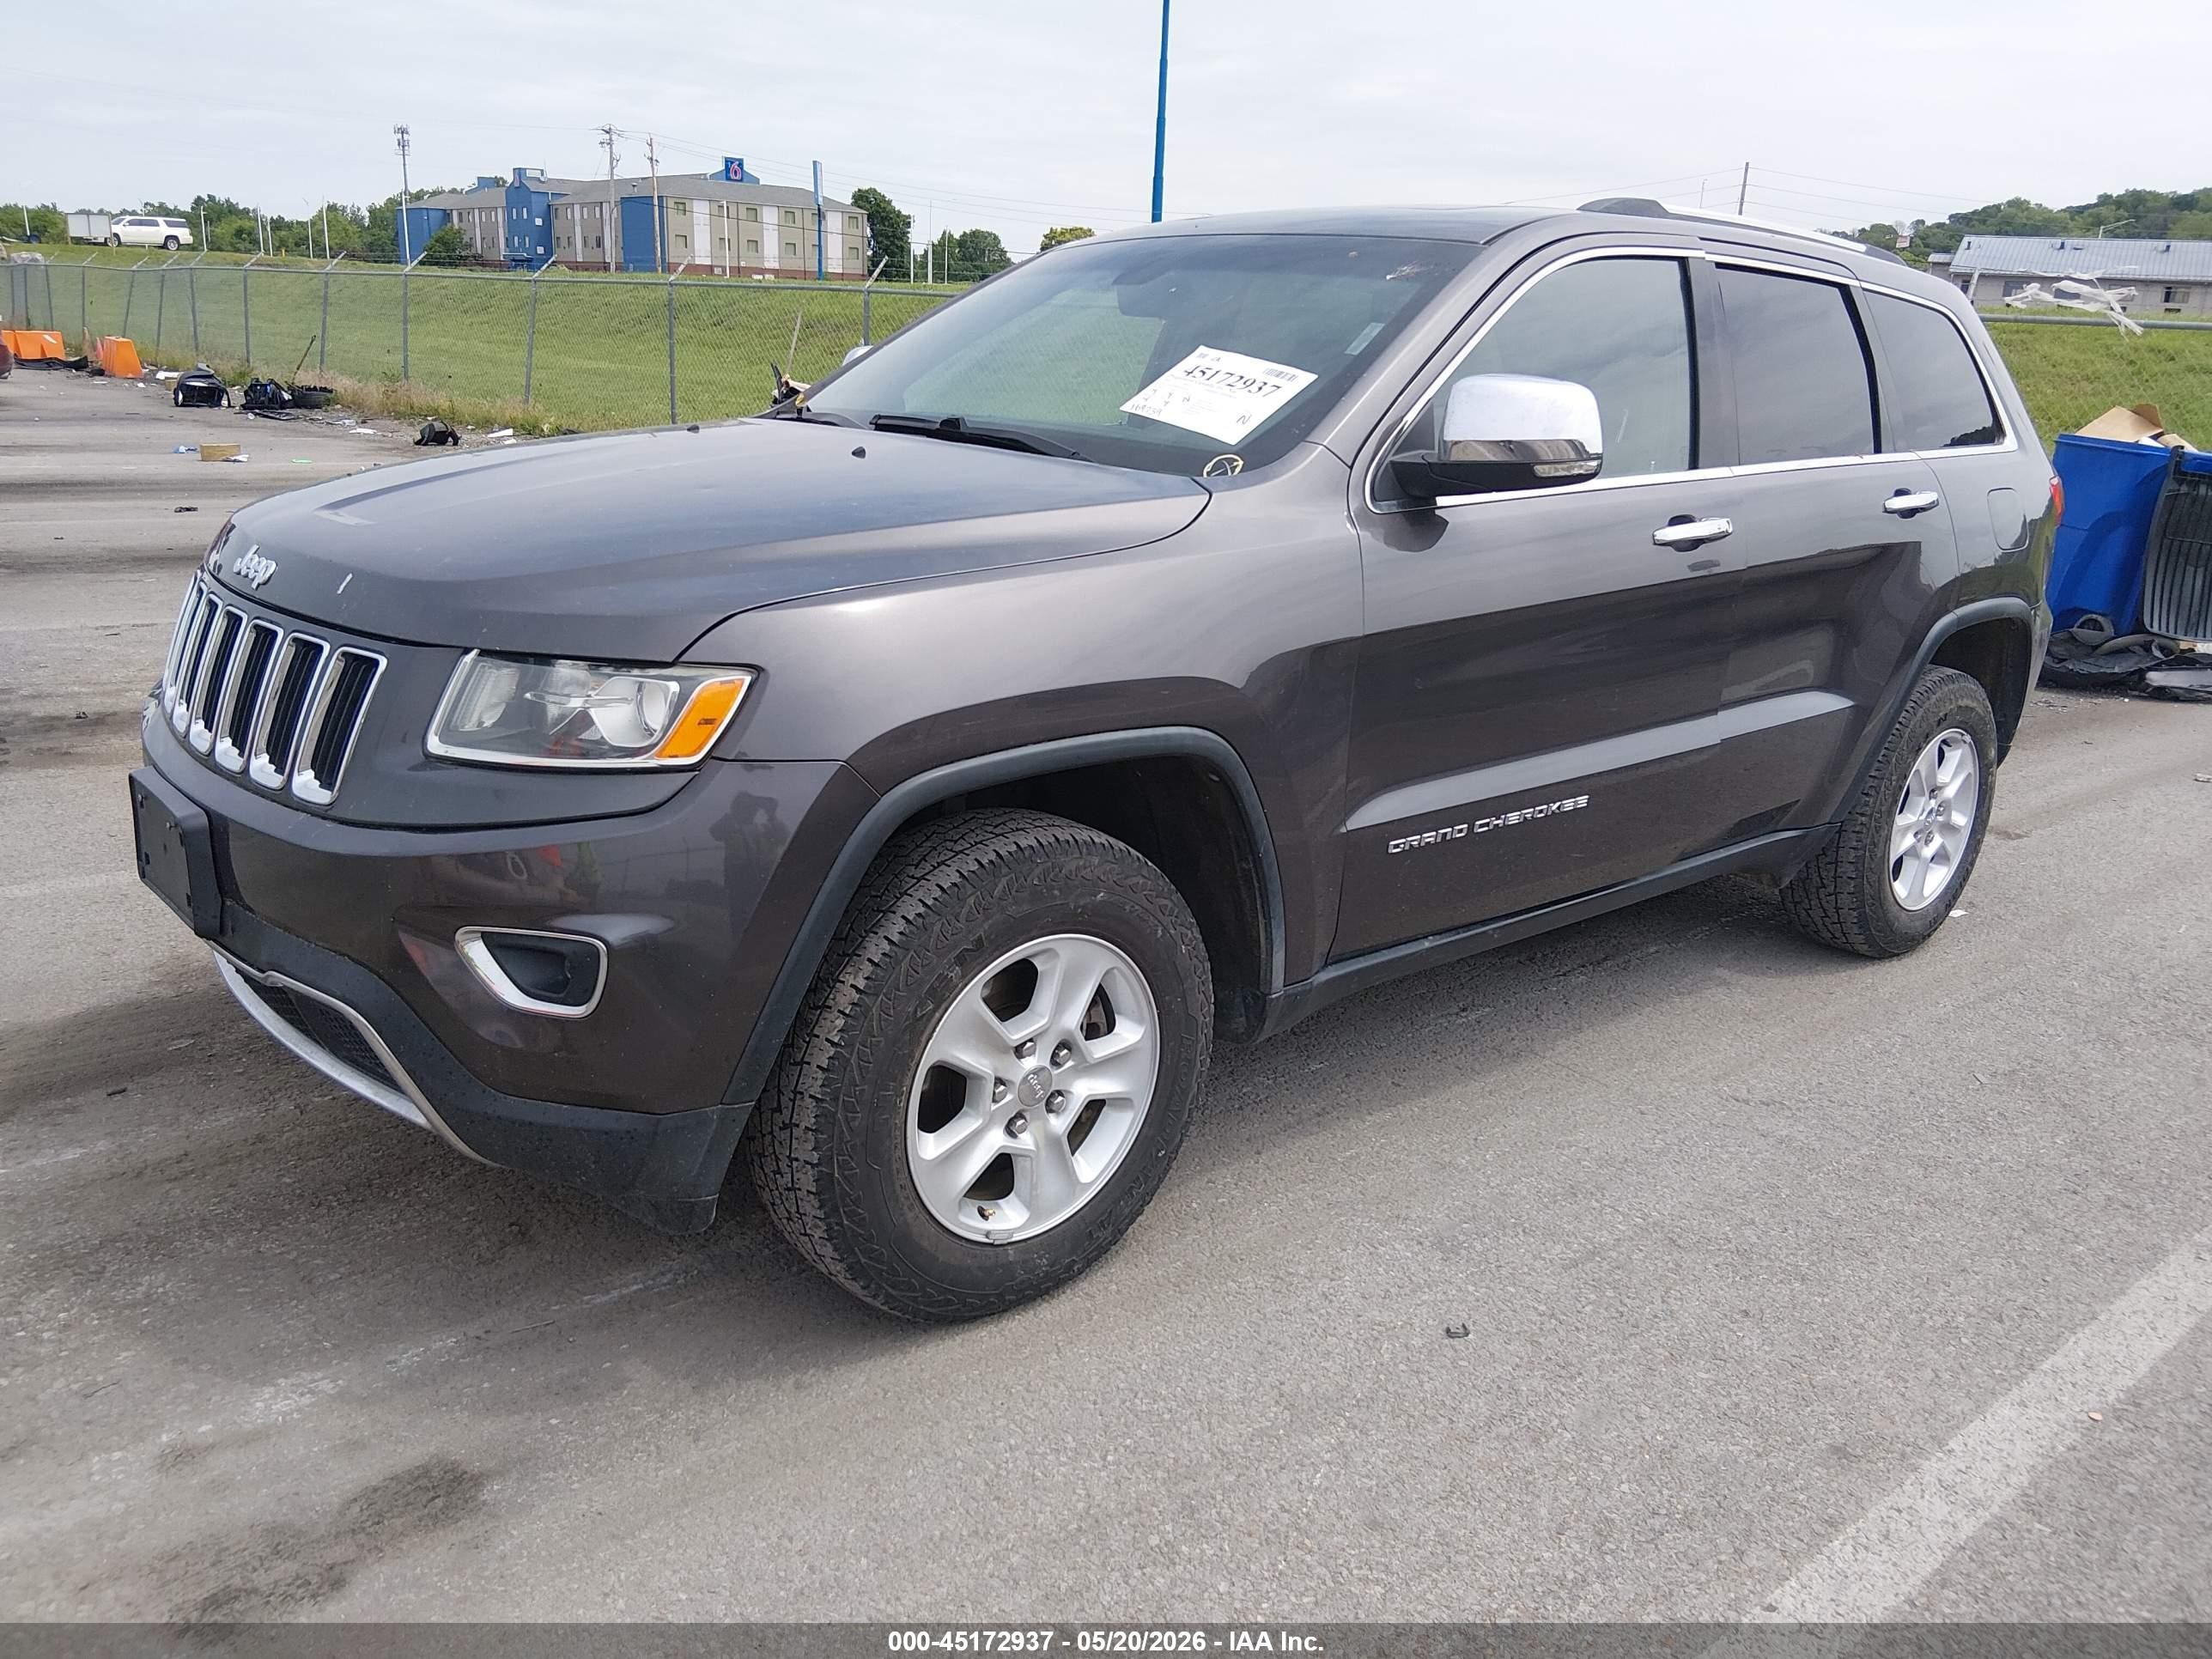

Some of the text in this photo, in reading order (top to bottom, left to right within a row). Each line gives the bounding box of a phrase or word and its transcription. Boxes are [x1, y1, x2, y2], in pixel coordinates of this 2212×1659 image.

[730, 161, 742, 180] 6
[1183, 364, 1282, 398] 45172937
[233, 544, 278, 592] Jeep
[1387, 794, 1590, 854] GRAND CHEROKEE
